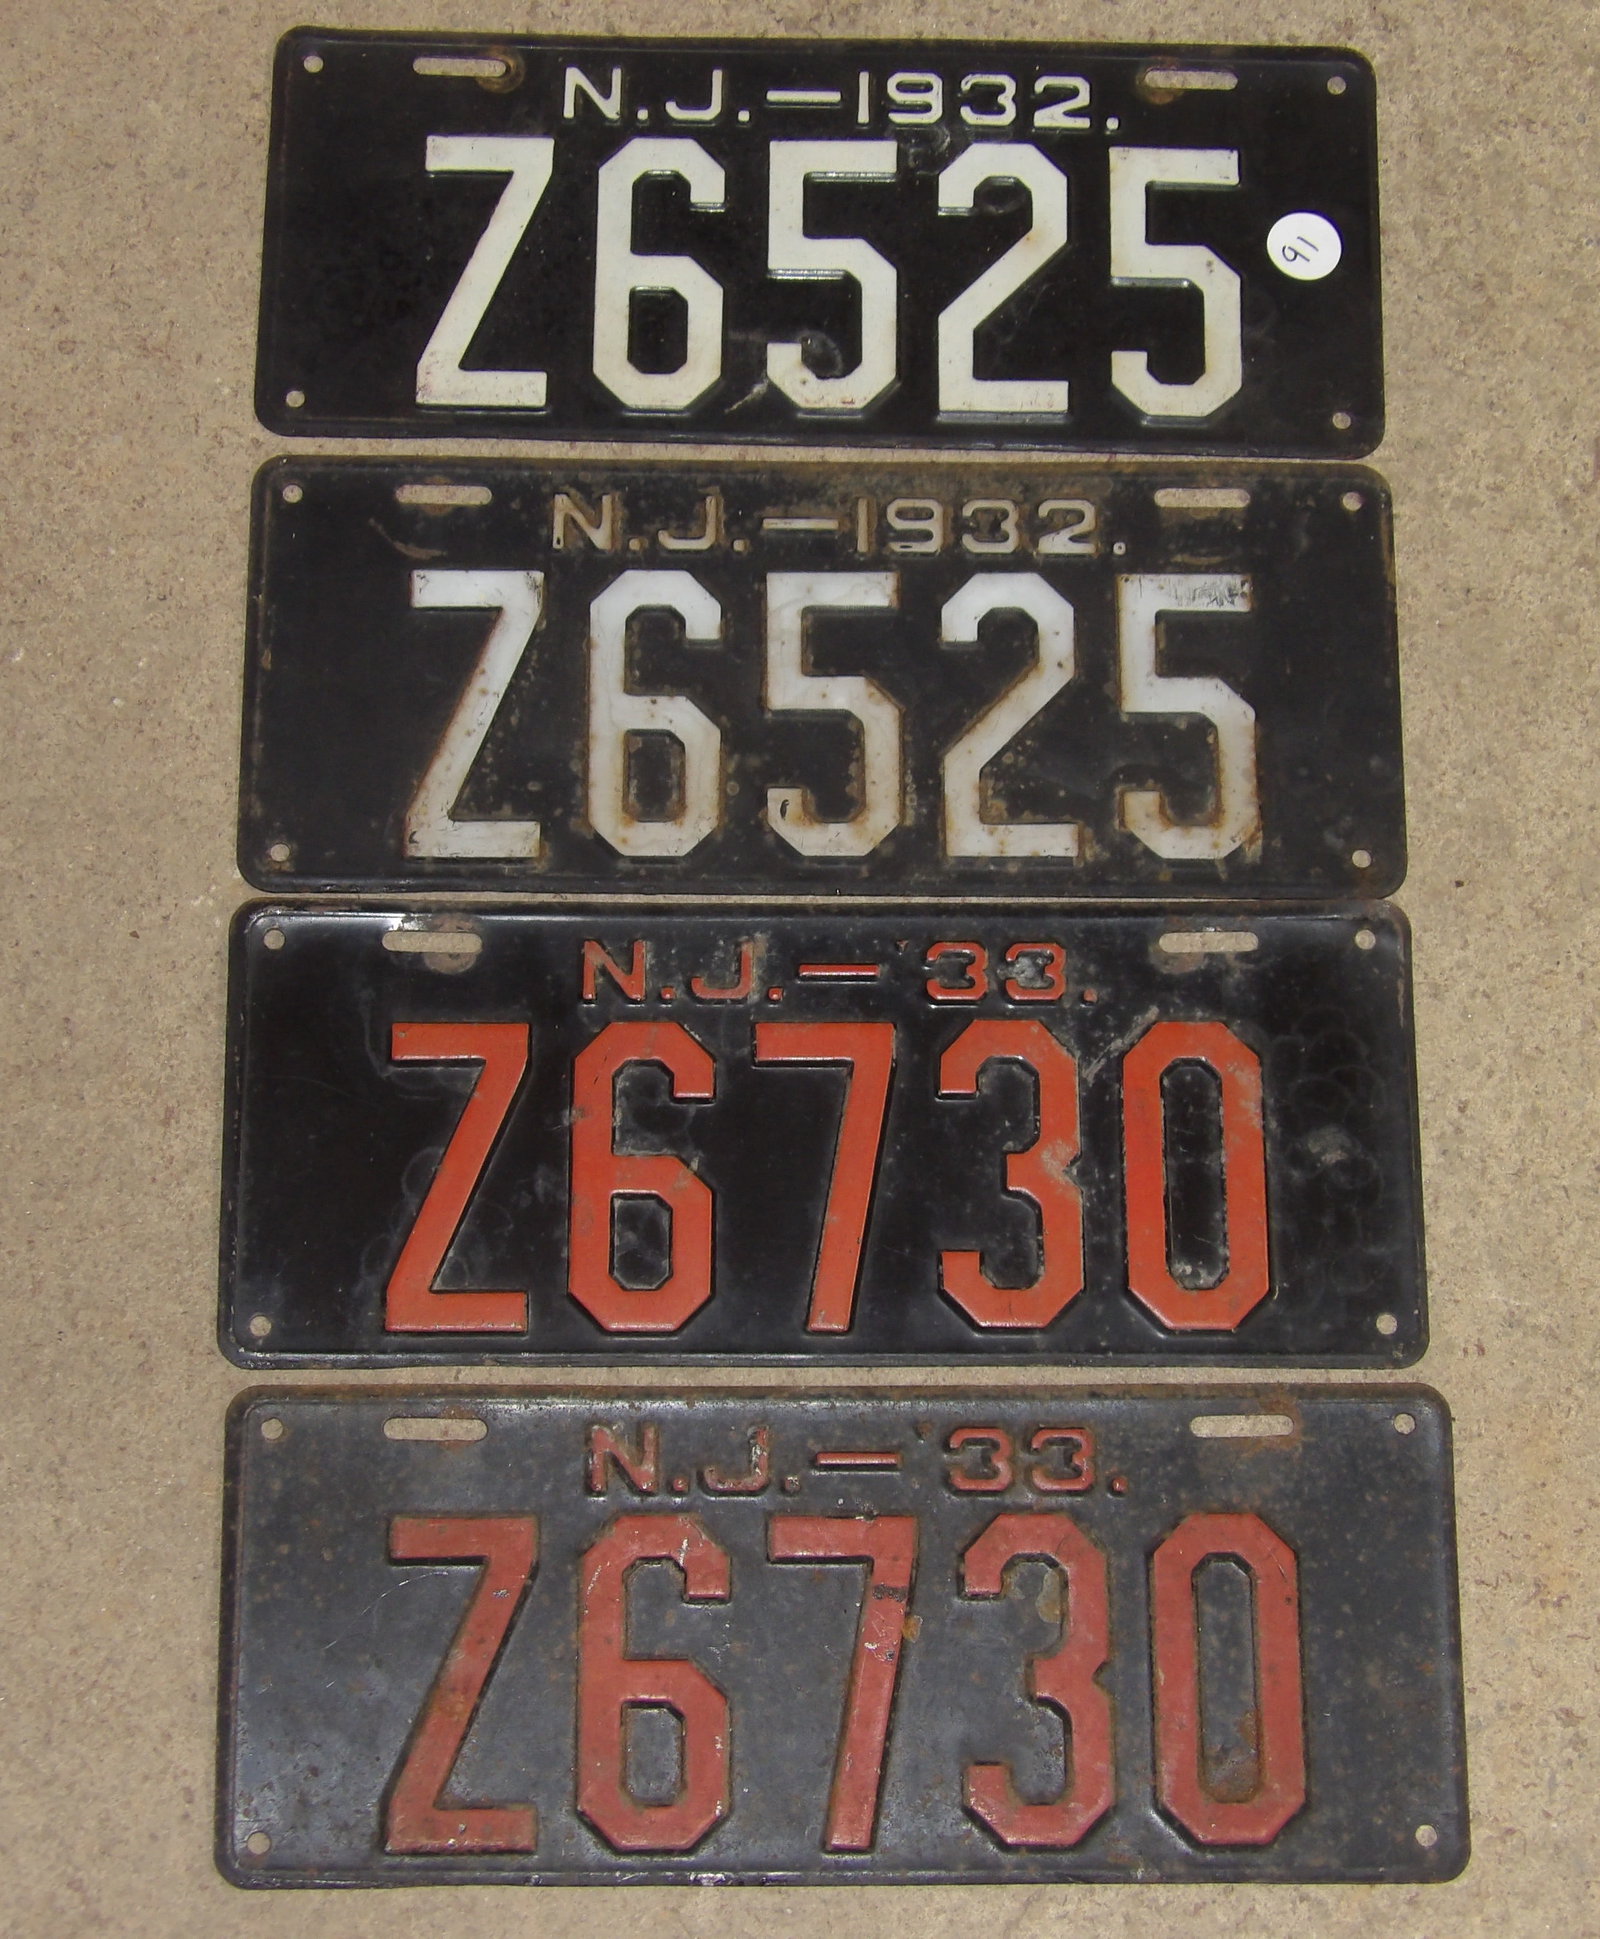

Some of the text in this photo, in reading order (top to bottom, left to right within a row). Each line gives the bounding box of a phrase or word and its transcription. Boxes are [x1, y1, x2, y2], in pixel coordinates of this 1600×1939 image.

[415, 135, 1243, 423] Z6525
[405, 569, 1260, 860] Z6525
[384, 1019, 1272, 1334] Z6730
[384, 1512, 1308, 1856] Z6730
